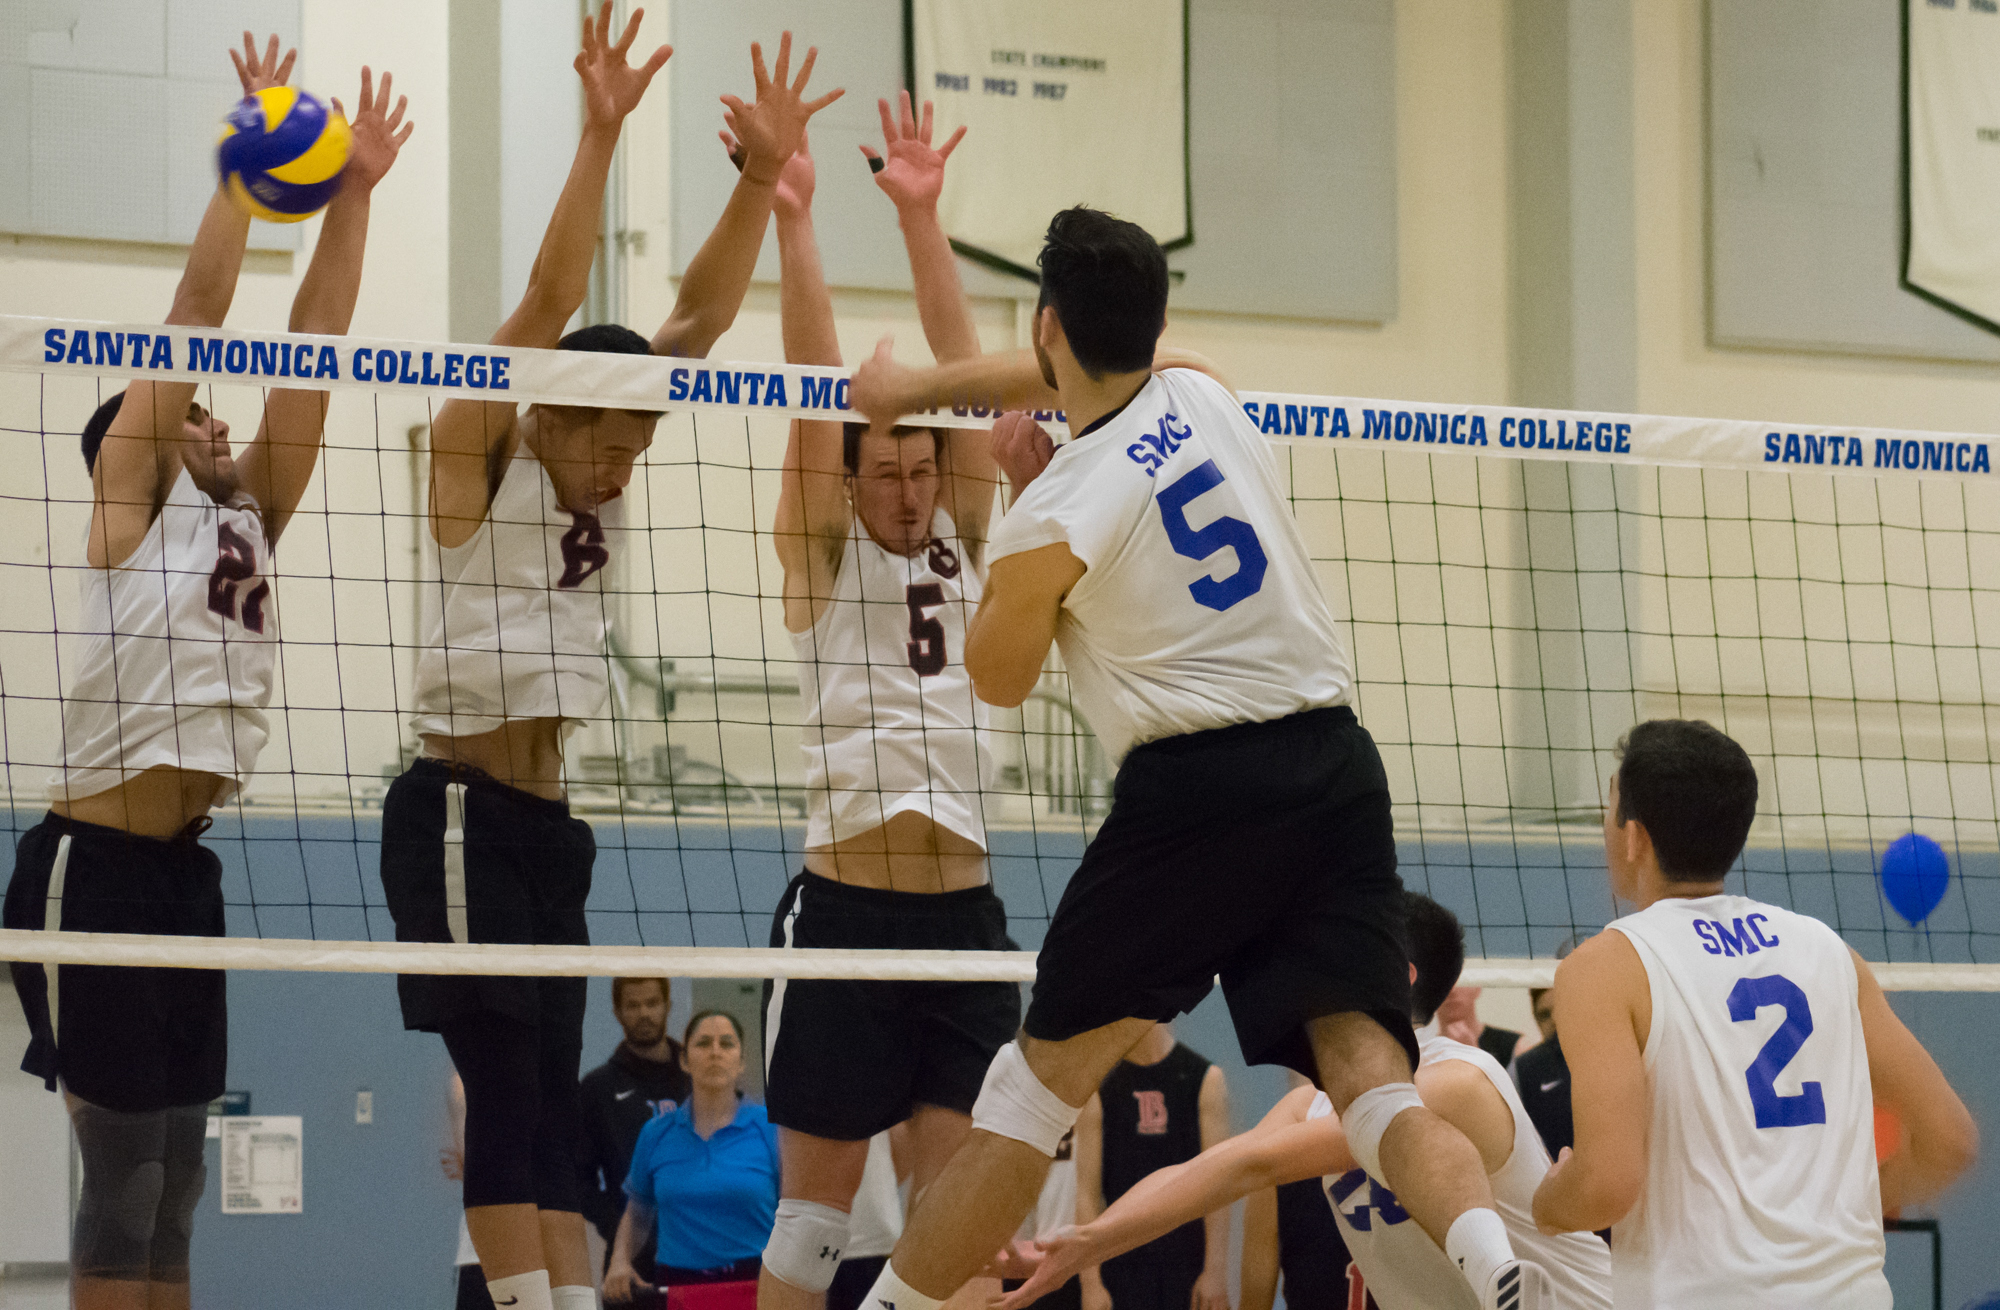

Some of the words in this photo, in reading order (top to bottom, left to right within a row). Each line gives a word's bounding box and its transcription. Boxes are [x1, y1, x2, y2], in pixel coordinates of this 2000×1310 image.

[44, 328, 173, 369] SANTA
[188, 337, 339, 379] MONICA
[352, 347, 510, 389] COLLEGE
[669, 368, 787, 407] SANTA
[1127, 412, 1192, 478] SMC
[1243, 402, 1351, 438] SANTA
[1361, 409, 1488, 446] MONICA
[1499, 417, 1631, 454] COLLEGE
[1764, 432, 1863, 467] SANTA
[1874, 438, 1990, 473] MONICA
[1155, 458, 1268, 612] 5
[907, 583, 947, 677] 5
[1693, 913, 1779, 957] SMC
[1726, 974, 1826, 1129] 2
